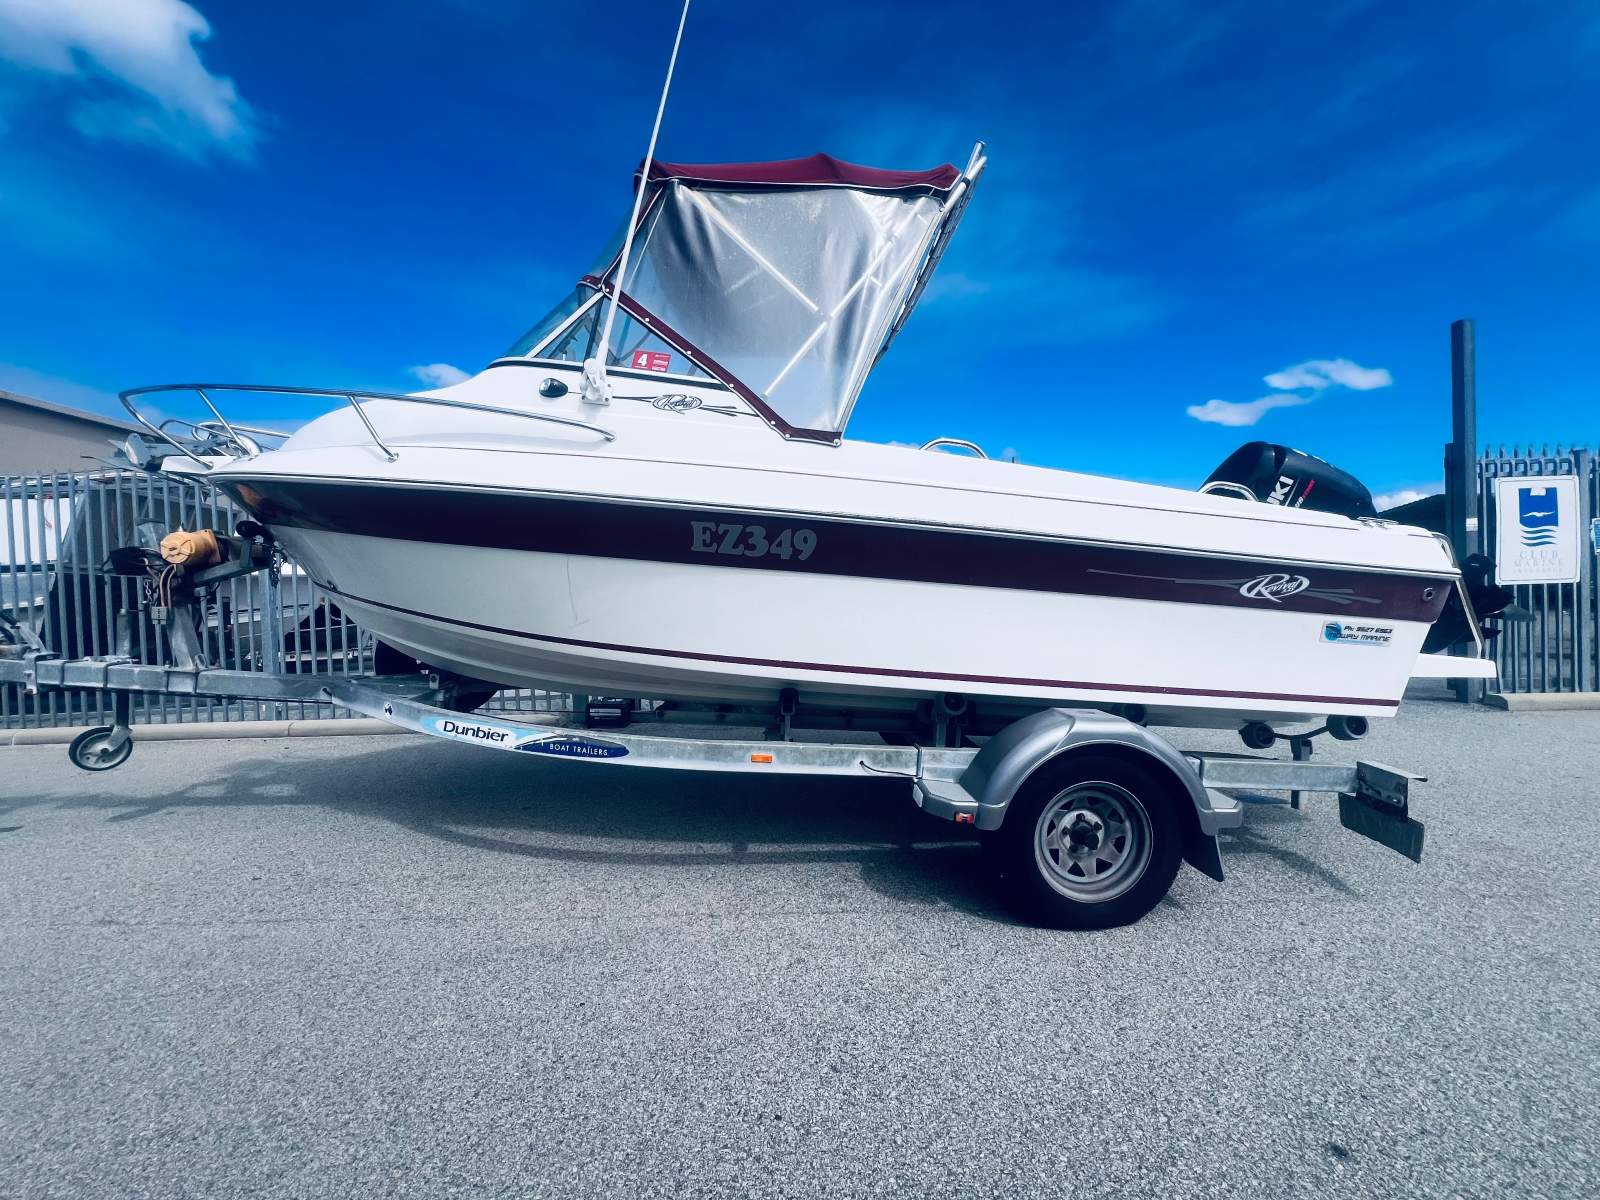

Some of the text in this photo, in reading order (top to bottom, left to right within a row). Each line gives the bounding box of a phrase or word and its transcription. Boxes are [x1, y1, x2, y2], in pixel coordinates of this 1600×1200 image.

[637, 353, 648, 367] 4
[690, 521, 818, 561] EZ349
[443, 720, 509, 742] Dunbier
[549, 743, 608, 756] BOAT TRAILERS
